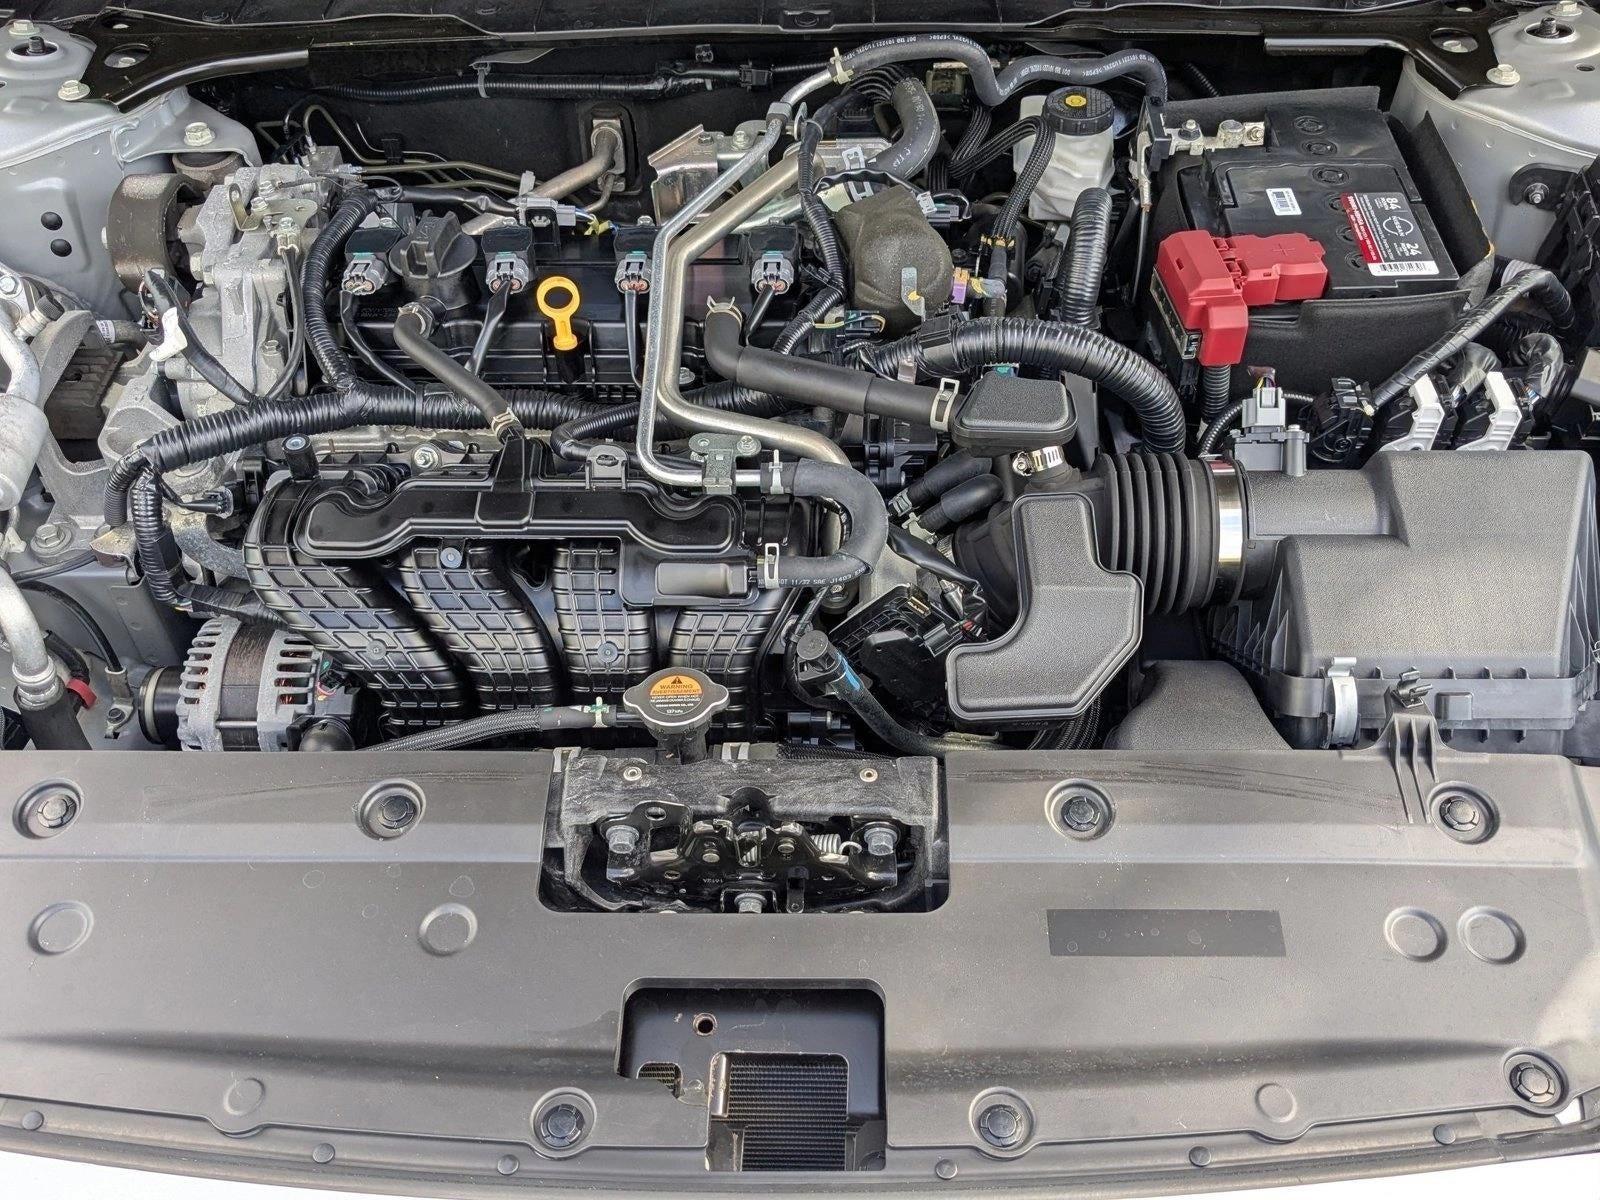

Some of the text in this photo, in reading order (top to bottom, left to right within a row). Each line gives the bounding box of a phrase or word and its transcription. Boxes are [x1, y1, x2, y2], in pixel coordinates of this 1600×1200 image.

[1386, 196, 1402, 210] 84
[1391, 215, 1405, 236] NISSAN
[1406, 242, 1422, 255] 24
